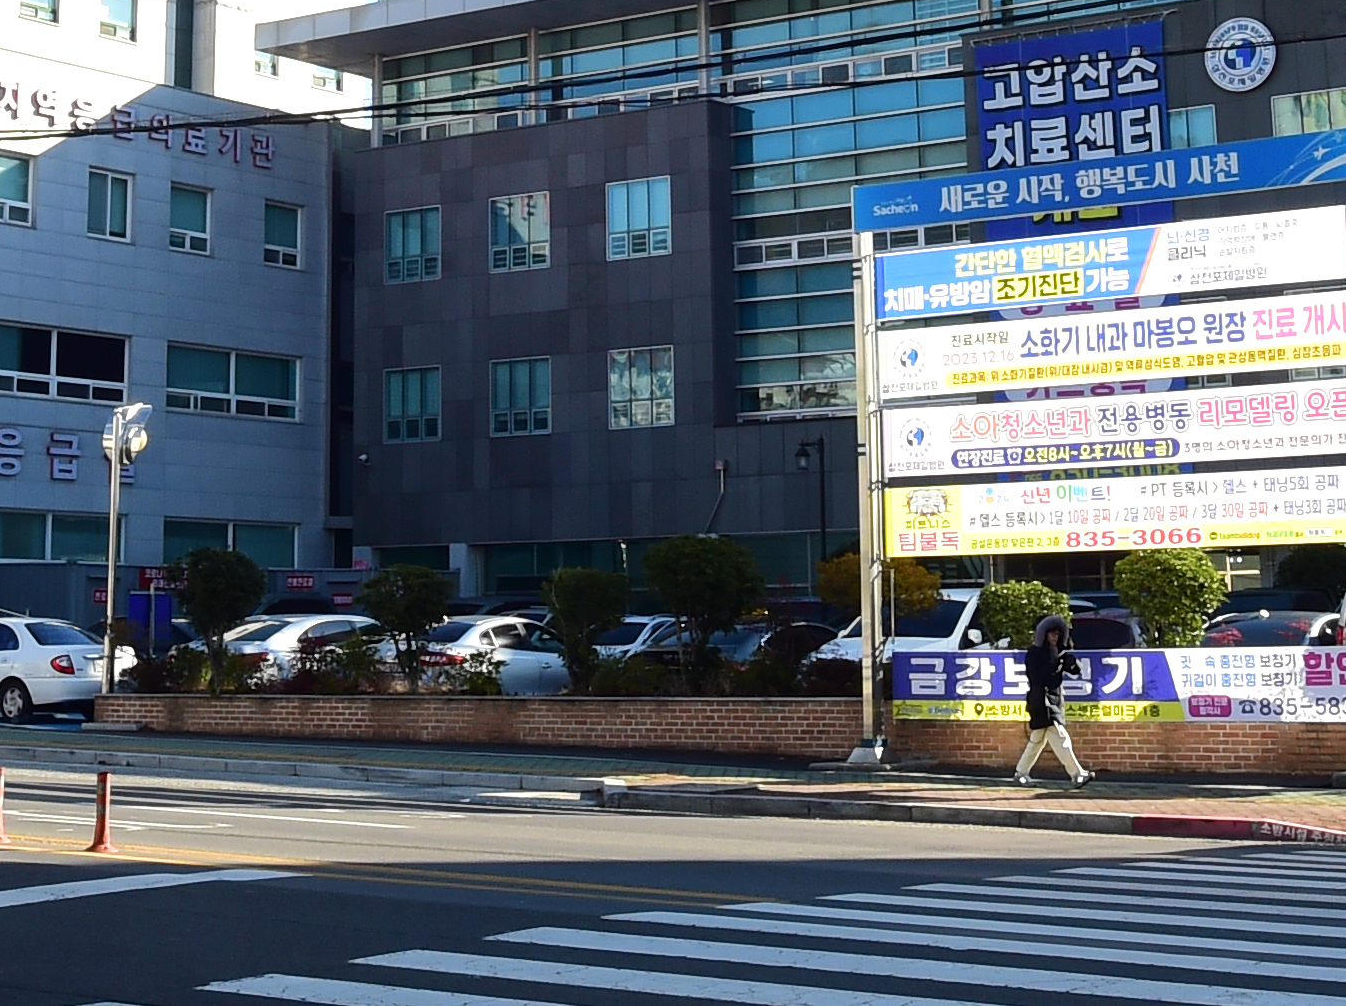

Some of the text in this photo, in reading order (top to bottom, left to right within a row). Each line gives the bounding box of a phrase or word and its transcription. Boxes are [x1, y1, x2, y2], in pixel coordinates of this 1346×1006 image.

[982, 46, 1159, 111] 고압산소
[985, 103, 1164, 171] 치료센터
[939, 180, 1010, 213] 새로운
[1016, 173, 1070, 204] 시작,
[1075, 161, 1176, 199] 행복도시
[1189, 152, 1240, 184] 사천
[955, 237, 1129, 278] 간단한 혈액검사로
[996, 271, 1080, 300] 조기진단
[1086, 267, 1131, 293] 가능
[1020, 325, 1080, 358] 소화기
[1087, 321, 1128, 353] 내과
[1133, 315, 1198, 349] 마봉오
[1203, 311, 1246, 344] 원장
[1253, 307, 1297, 340] 진료
[951, 409, 1092, 441] 소아청소년과
[1097, 402, 1192, 434] 전용병동
[1199, 393, 1297, 427] 리모델링
[957, 449, 1004, 468] 연장진료
[1021, 487, 1051, 505] 신년
[1056, 485, 1112, 502] 이벤트!
[898, 531, 960, 552] 팀불독
[1066, 527, 1202, 549] 835-3066
[1260, 653, 1297, 668] 보청기
[1260, 672, 1297, 687] 보청기
